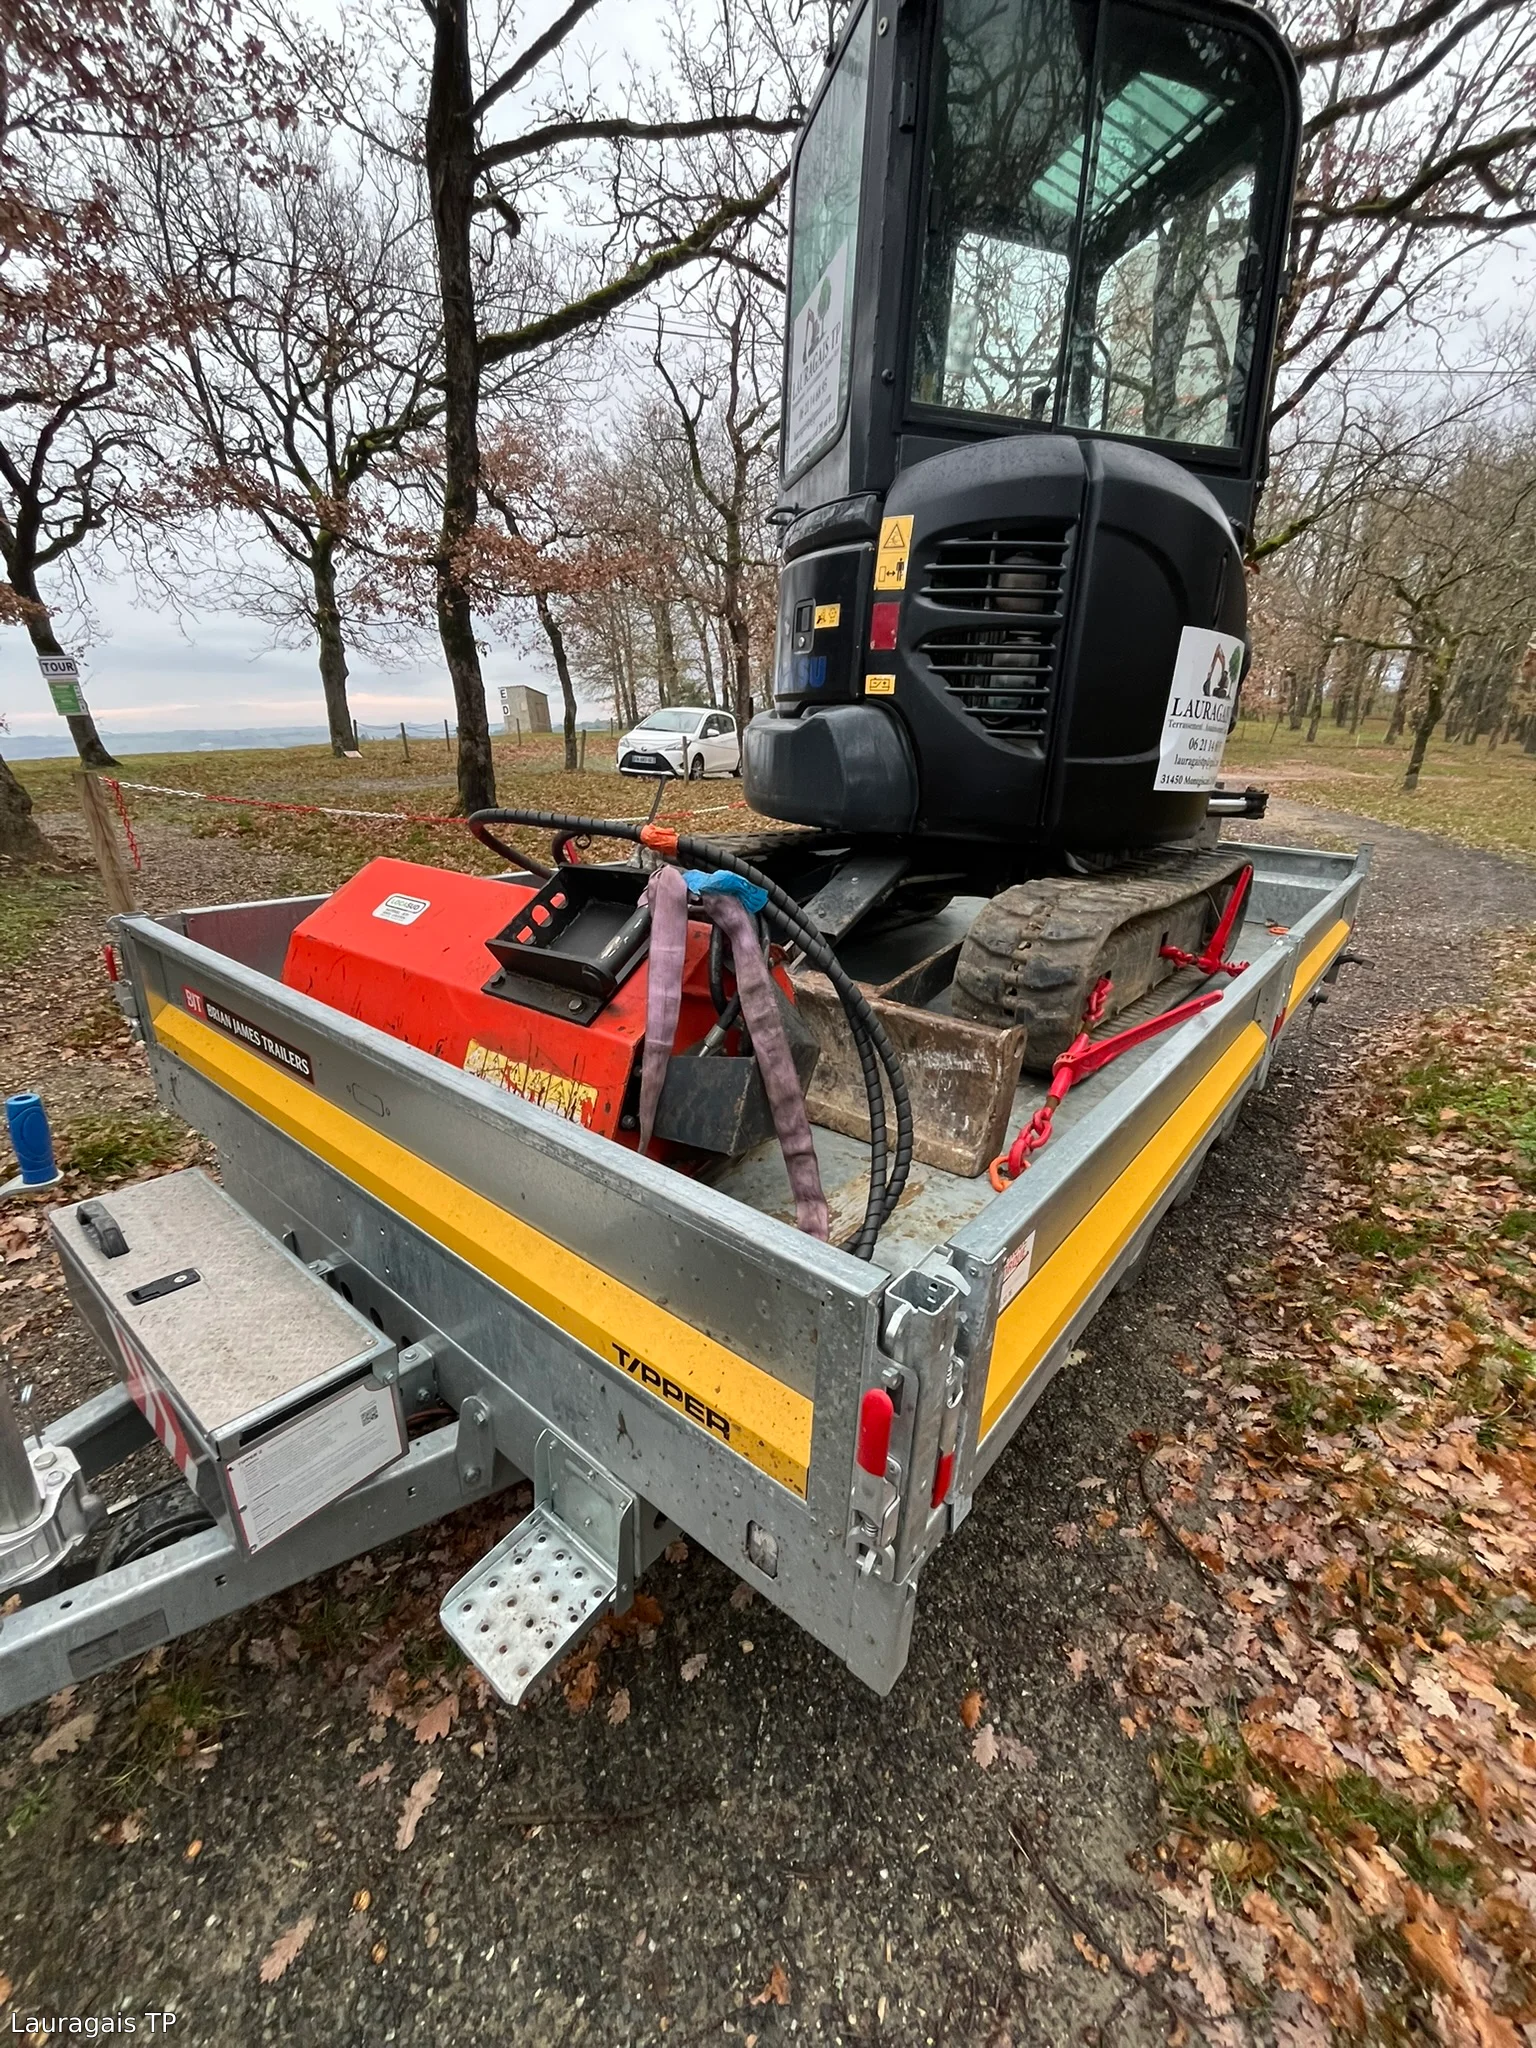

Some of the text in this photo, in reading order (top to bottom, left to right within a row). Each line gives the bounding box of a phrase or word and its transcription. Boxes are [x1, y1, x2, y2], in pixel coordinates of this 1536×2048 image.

[42, 662, 75, 672] TOUR
[500, 689, 507, 699] E
[502, 705, 509, 715] D
[1188, 737, 1199, 751] 06
[1199, 738, 1208, 751] 21
[1160, 774, 1184, 785] 31450
[206, 1003, 233, 1029] BRIAN
[232, 1018, 261, 1047] JAMES
[261, 1034, 310, 1075] TRAILERS
[611, 1341, 730, 1441] TIPPER
